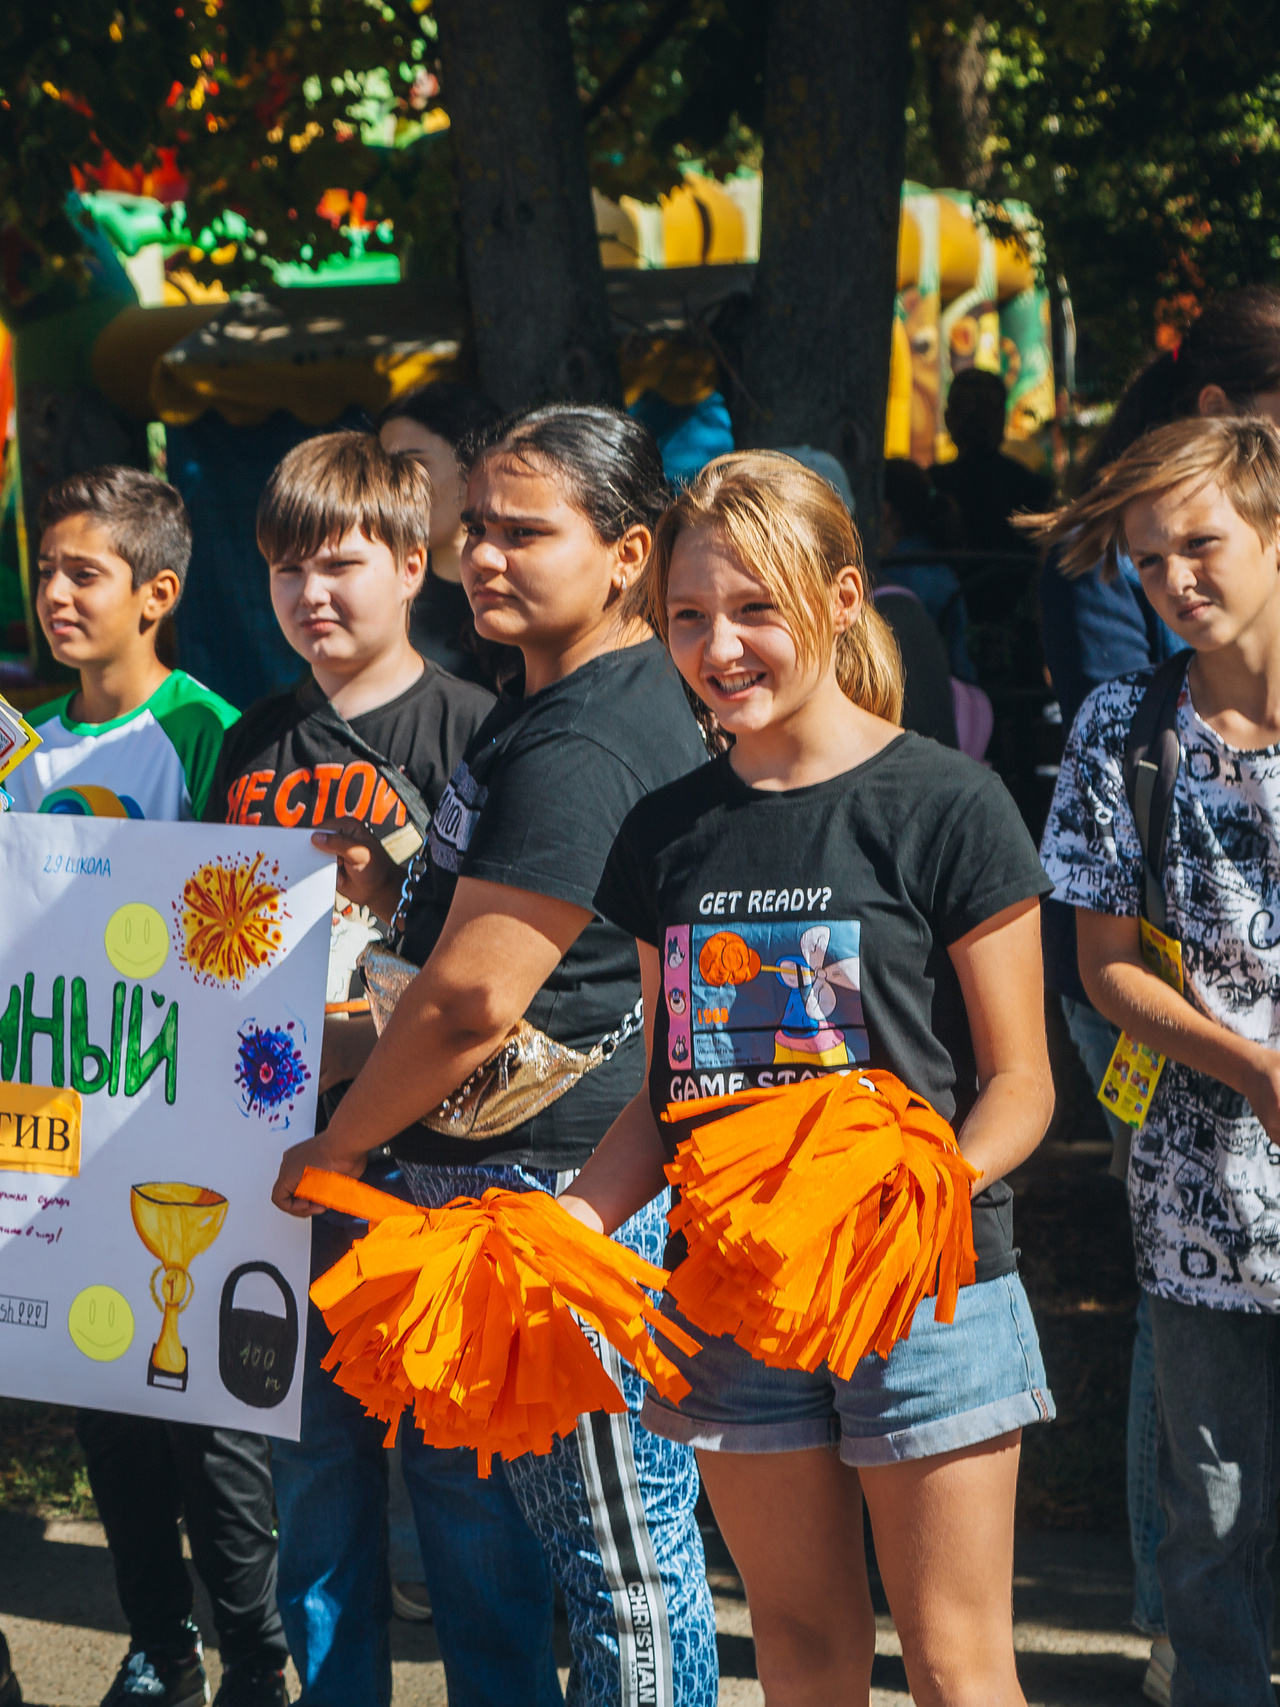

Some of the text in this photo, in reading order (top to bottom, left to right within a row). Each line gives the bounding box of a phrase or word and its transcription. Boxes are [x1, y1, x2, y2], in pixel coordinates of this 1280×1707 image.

[43, 854, 112, 878] 29 ШКОЛА
[699, 886, 832, 915] GET READY?
[670, 1071, 745, 1103] GAME
[240, 1341, 276, 1370] 100
[626, 1581, 657, 1704] CHRISTIAN
